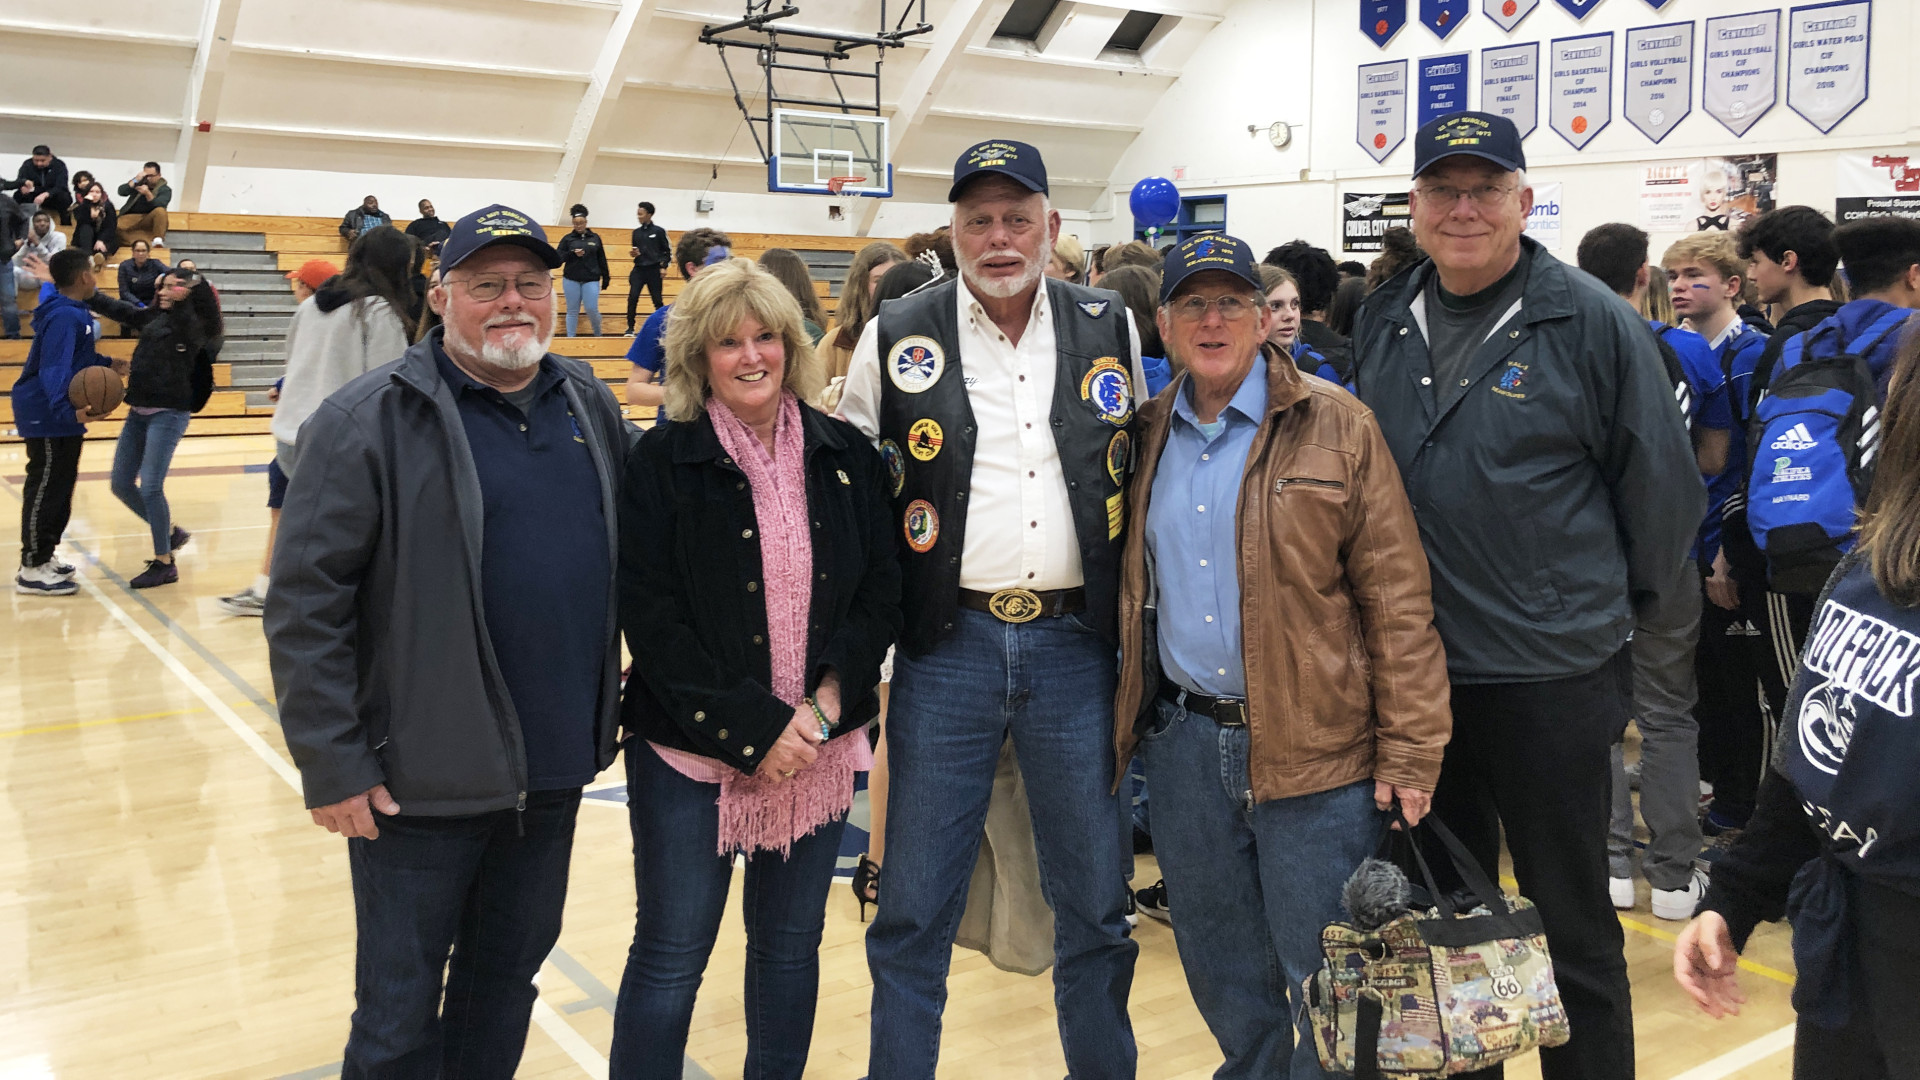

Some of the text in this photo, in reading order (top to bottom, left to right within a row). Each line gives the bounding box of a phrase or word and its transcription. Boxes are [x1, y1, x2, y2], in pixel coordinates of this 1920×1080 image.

[1793, 34, 1864, 48] GIRLS WATER POLO
[1710, 46, 1772, 58] GIRLS VOLLEYBALL
[1630, 56, 1688, 68] GIRLS VOLLEYBALL
[1554, 66, 1608, 78] GIRLS BASKETBALL
[1721, 68, 1760, 78] CHAMPIONS
[1804, 64, 1849, 74] CHAMPIONS
[1484, 74, 1534, 86] GIRLS BASKETBALL
[1640, 78, 1677, 87] CHAMPIONS
[1430, 84, 1456, 92] FOOTBALL
[1563, 87, 1597, 96] CHAMPIONS
[1732, 84, 1748, 92] 2017
[1374, 89, 1404, 98] BASKETBALL
[1438, 92, 1447, 100] CIF
[1496, 94, 1520, 102] FINALIST
[1430, 101, 1454, 110] FINALIST
[1447, 118, 1460, 126] NAVY
[1866, 199, 1892, 208] Proud
[1346, 220, 1372, 236] CULVER
[1372, 220, 1390, 236] CITY
[1194, 235, 1214, 244] NAVY
[1186, 256, 1234, 268] SEAWOLVES
[914, 422, 940, 436] TONKIN GULF
[1772, 494, 1810, 504] MAYNARD
[1803, 598, 1920, 717] OLFPACK
[1498, 978, 1518, 996] 66
